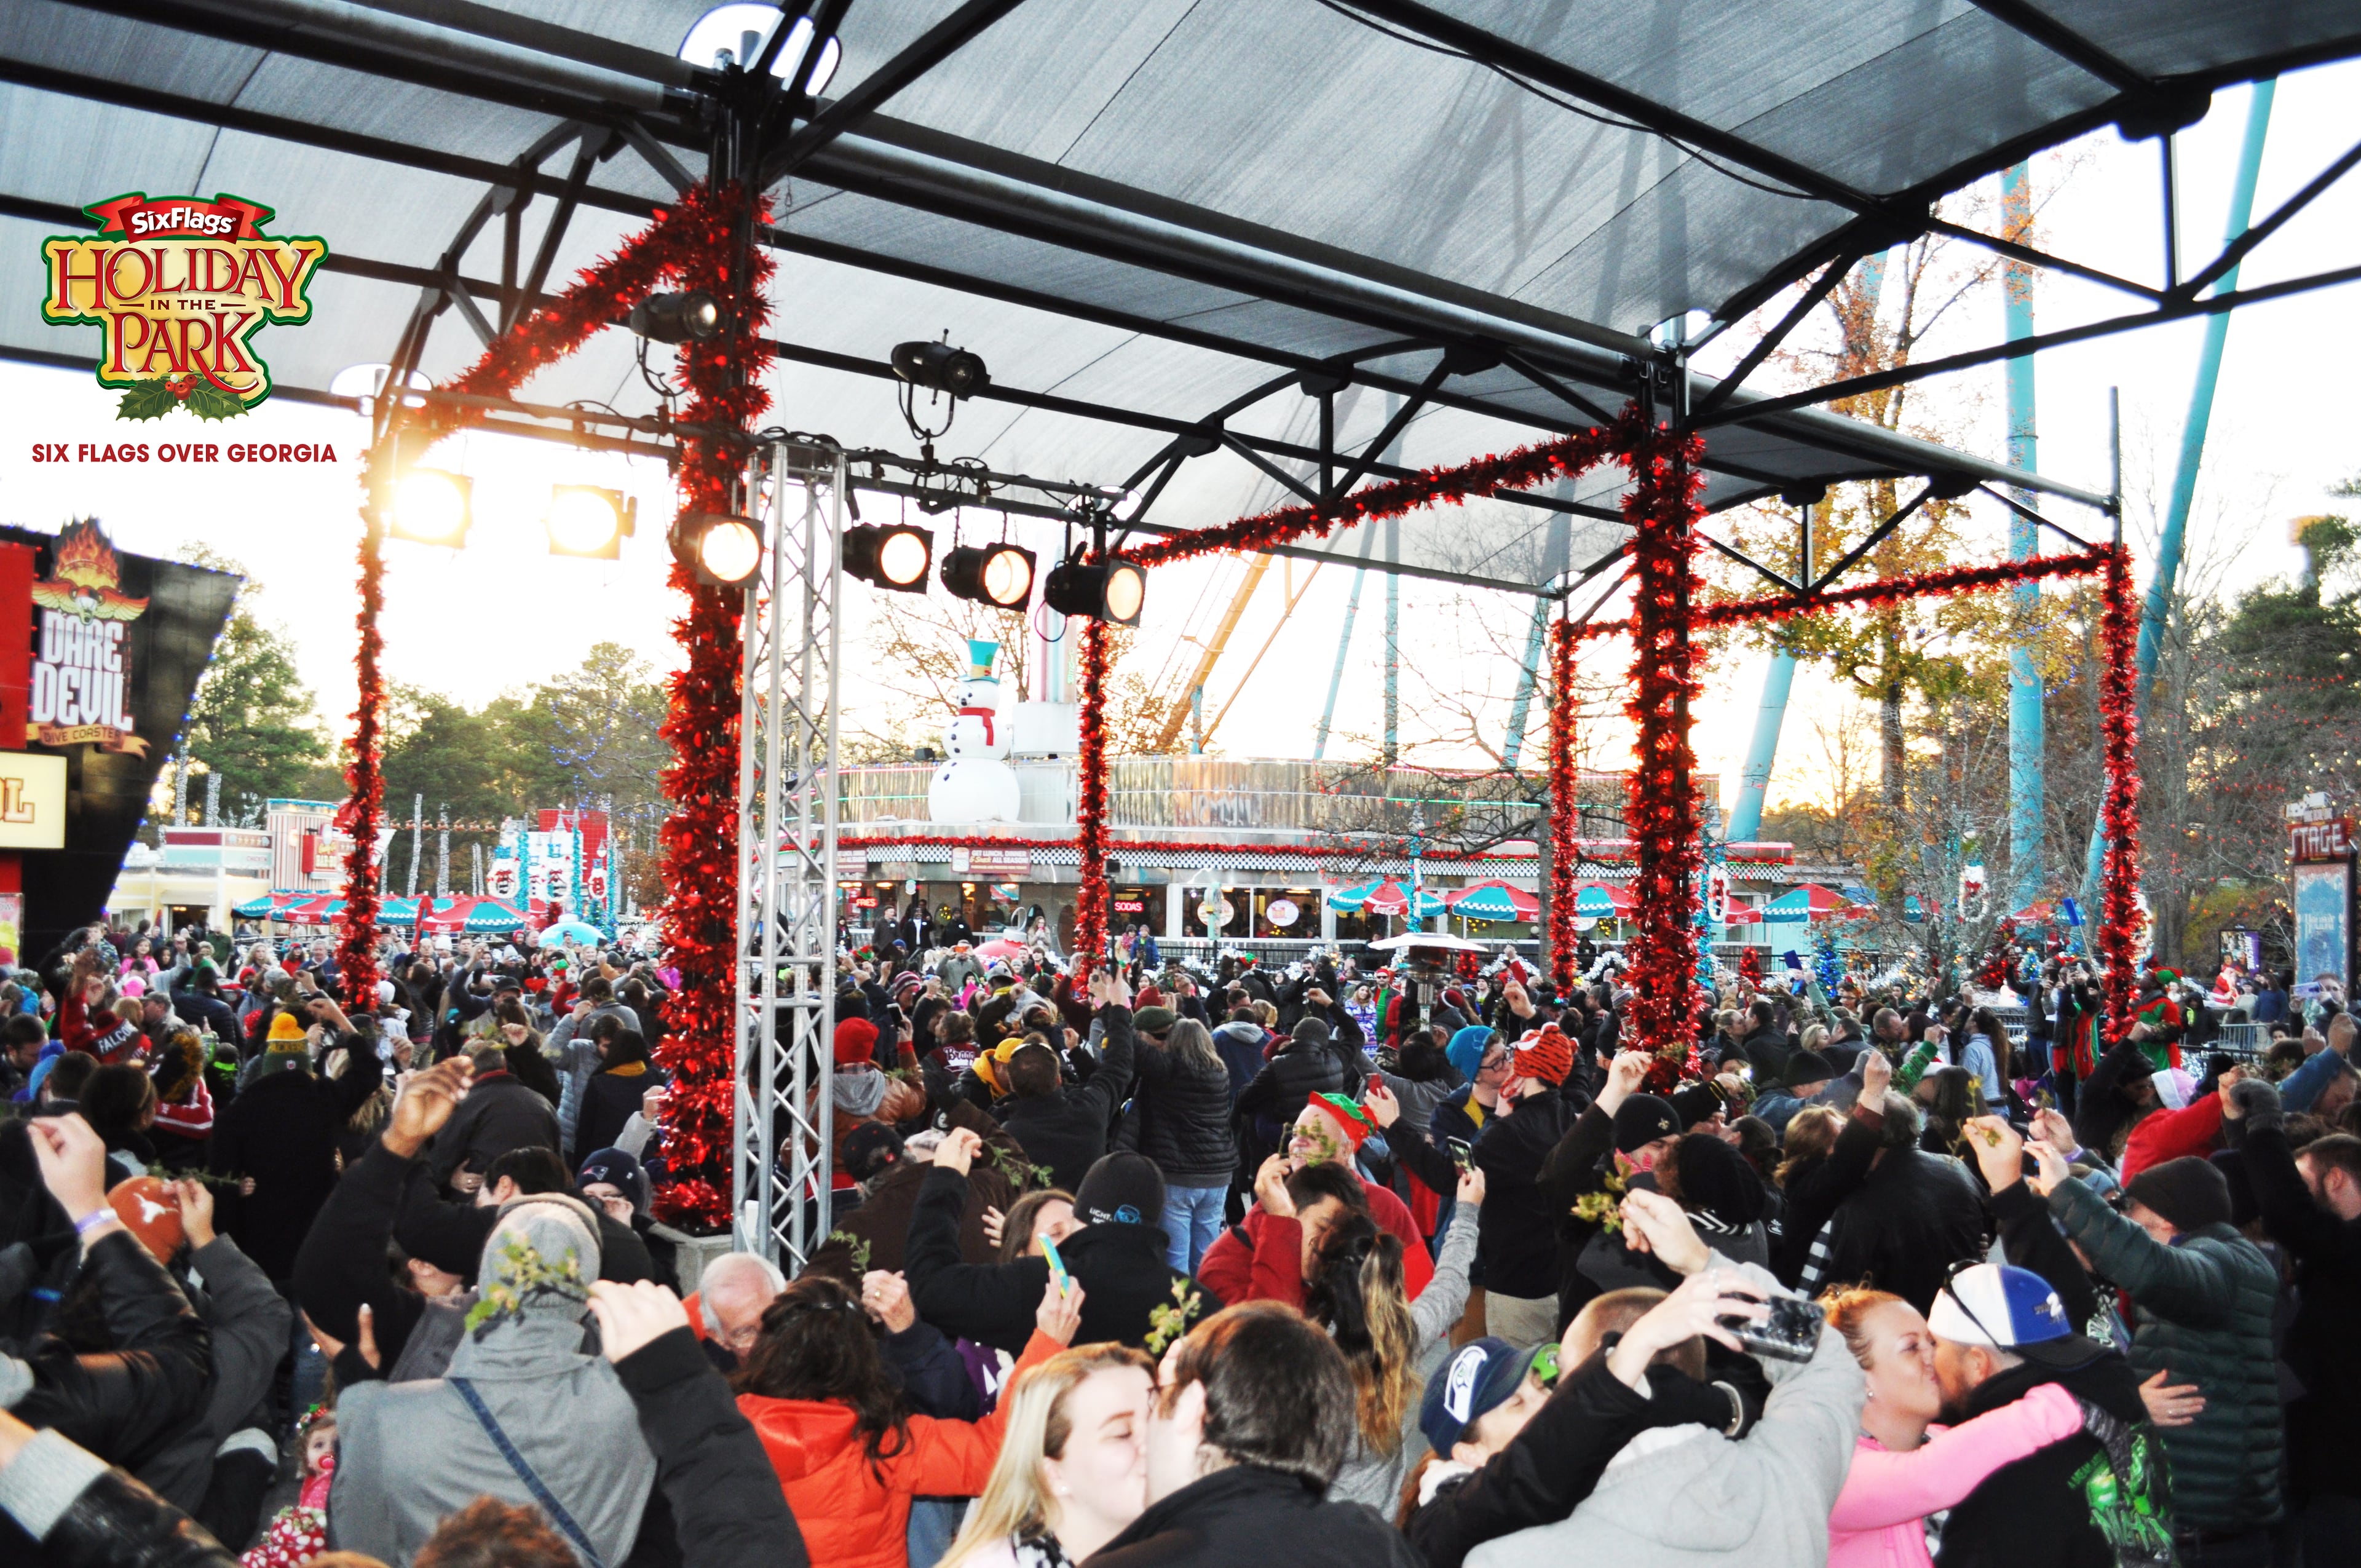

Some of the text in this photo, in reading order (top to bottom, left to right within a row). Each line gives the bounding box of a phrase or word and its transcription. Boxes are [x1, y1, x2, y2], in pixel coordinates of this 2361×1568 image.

[43, 611, 124, 673] DARE
[33, 662, 133, 732] DEVIL
[44, 726, 122, 743] DIVE COASTER
[0, 777, 35, 823] L
[2287, 823, 2346, 857] STAGE
[1114, 901, 1143, 911] SODAS
